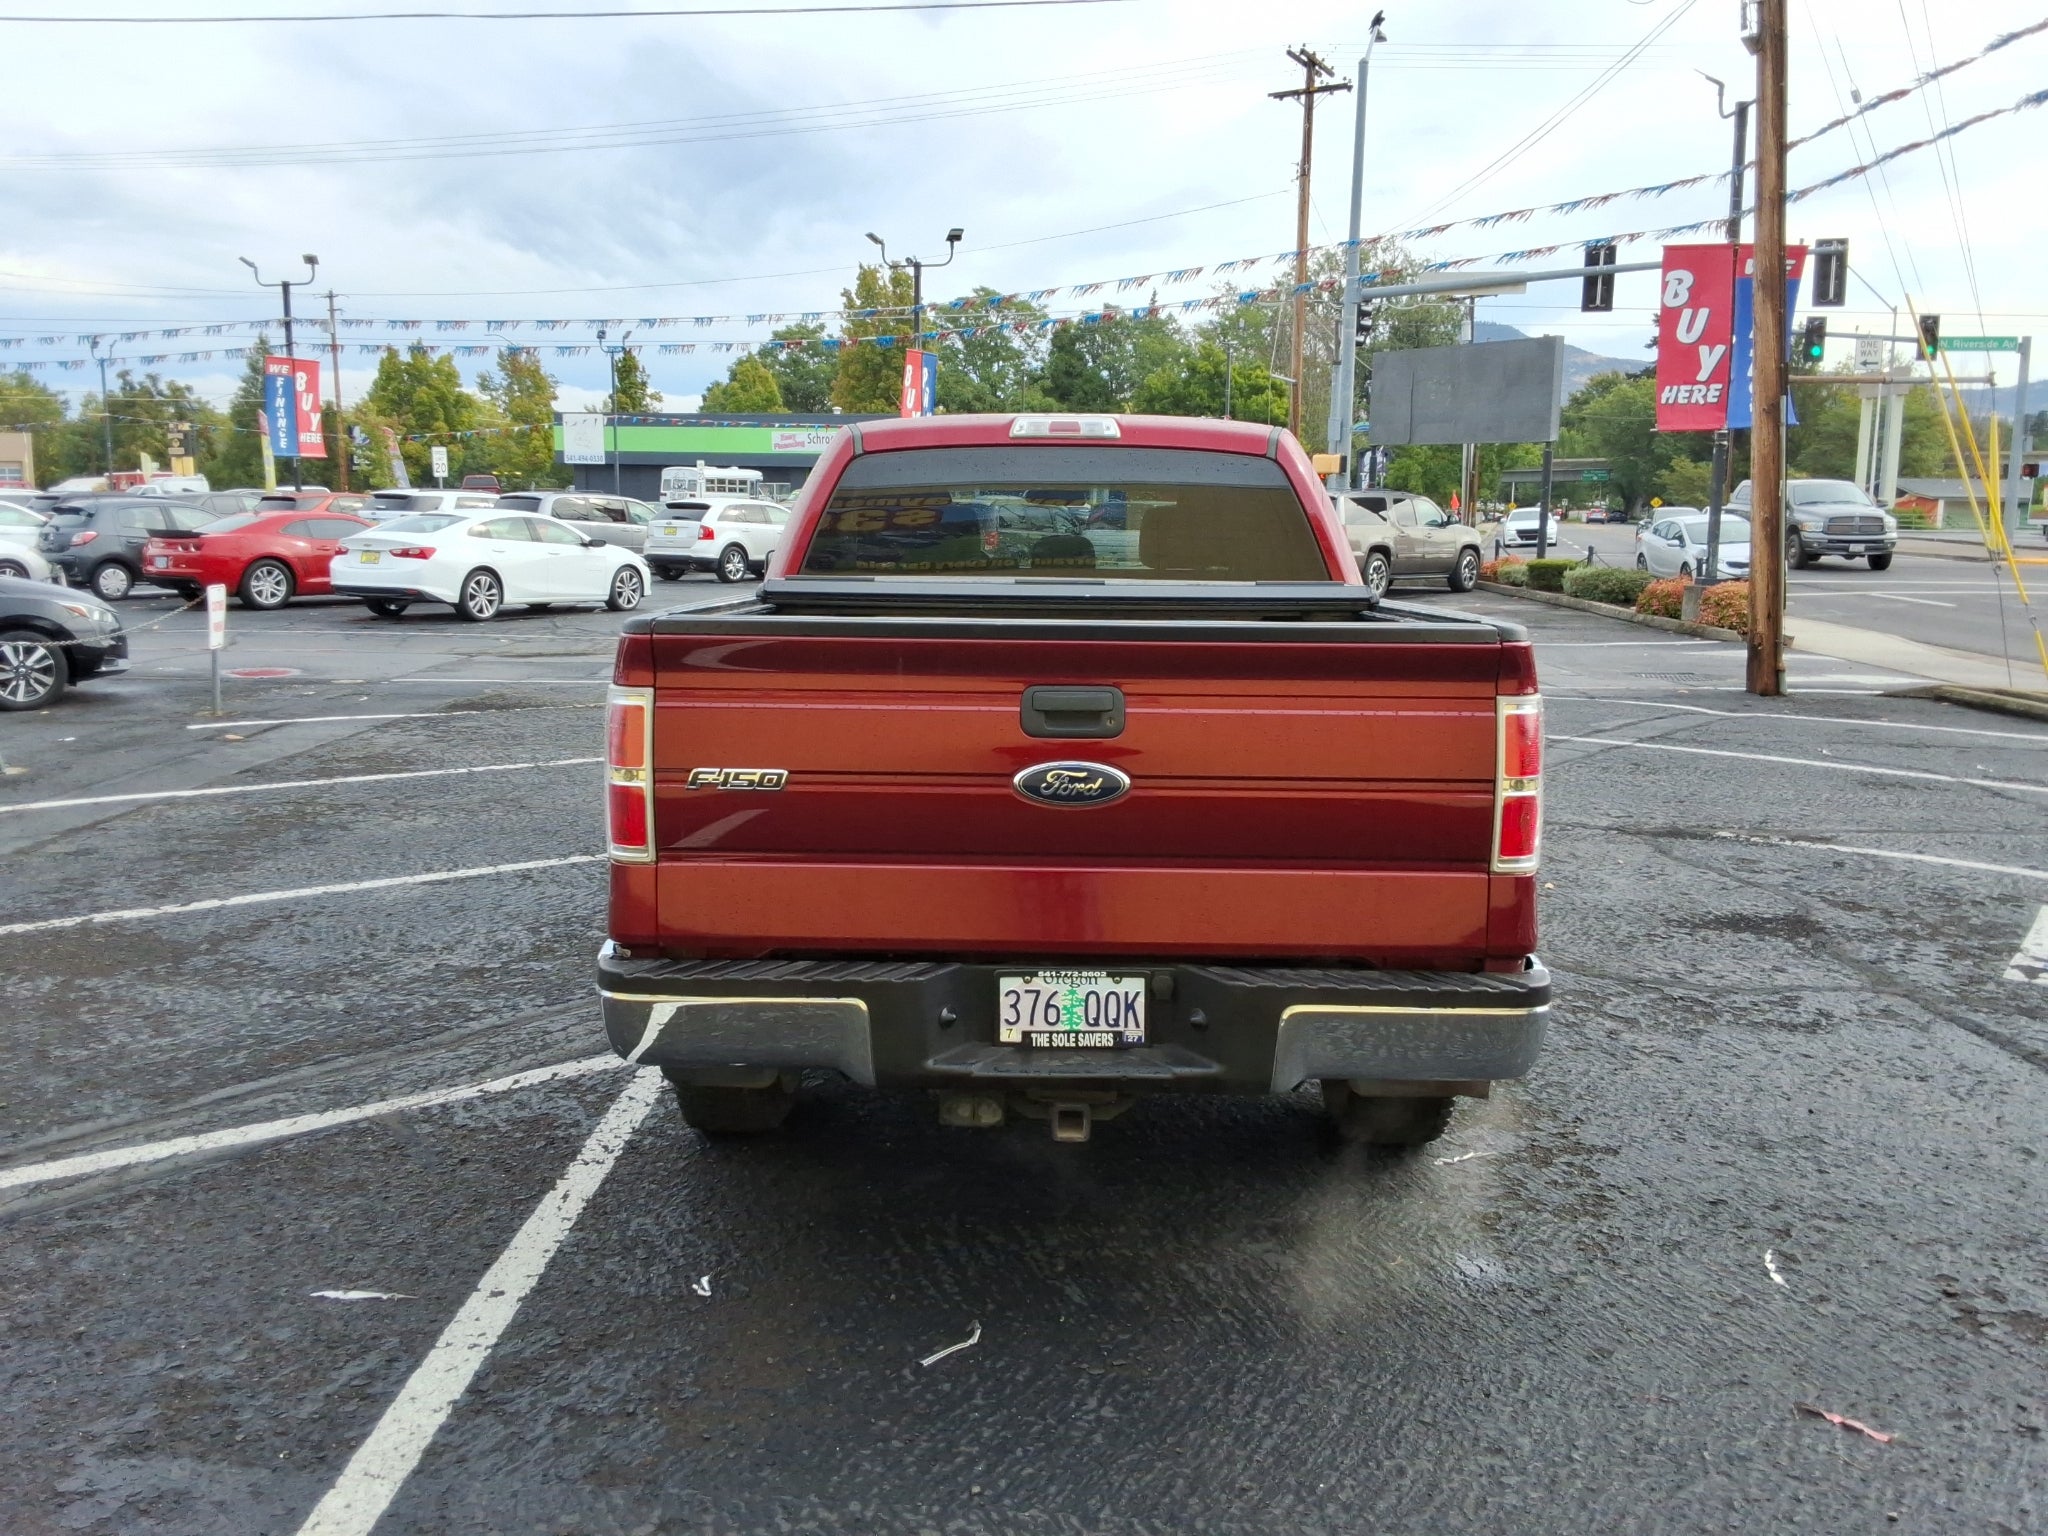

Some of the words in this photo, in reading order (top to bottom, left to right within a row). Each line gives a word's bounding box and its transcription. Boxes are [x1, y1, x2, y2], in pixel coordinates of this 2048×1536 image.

[1662, 269, 1726, 382] BUY
[1860, 341, 1878, 349] ONE
[1940, 340, 1950, 348] N.
[1860, 350, 1878, 358] WAY
[269, 364, 290, 374] WE
[1661, 383, 1723, 405] HERE
[296, 371, 321, 432] BUY
[275, 377, 288, 449] FINANCE
[300, 432, 323, 444] HERE
[435, 462, 447, 473] 20
[685, 767, 789, 790] F-150
[1040, 770, 1103, 796] Ford
[1043, 976, 1099, 989] Oregon
[1004, 989, 1061, 1027] 376
[1084, 990, 1142, 1029] QQK
[1006, 1029, 1014, 1039] 7
[1031, 1033, 1052, 1047] THE
[1053, 1033, 1077, 1047] SOLE
[1078, 1033, 1114, 1047] SAVERS
